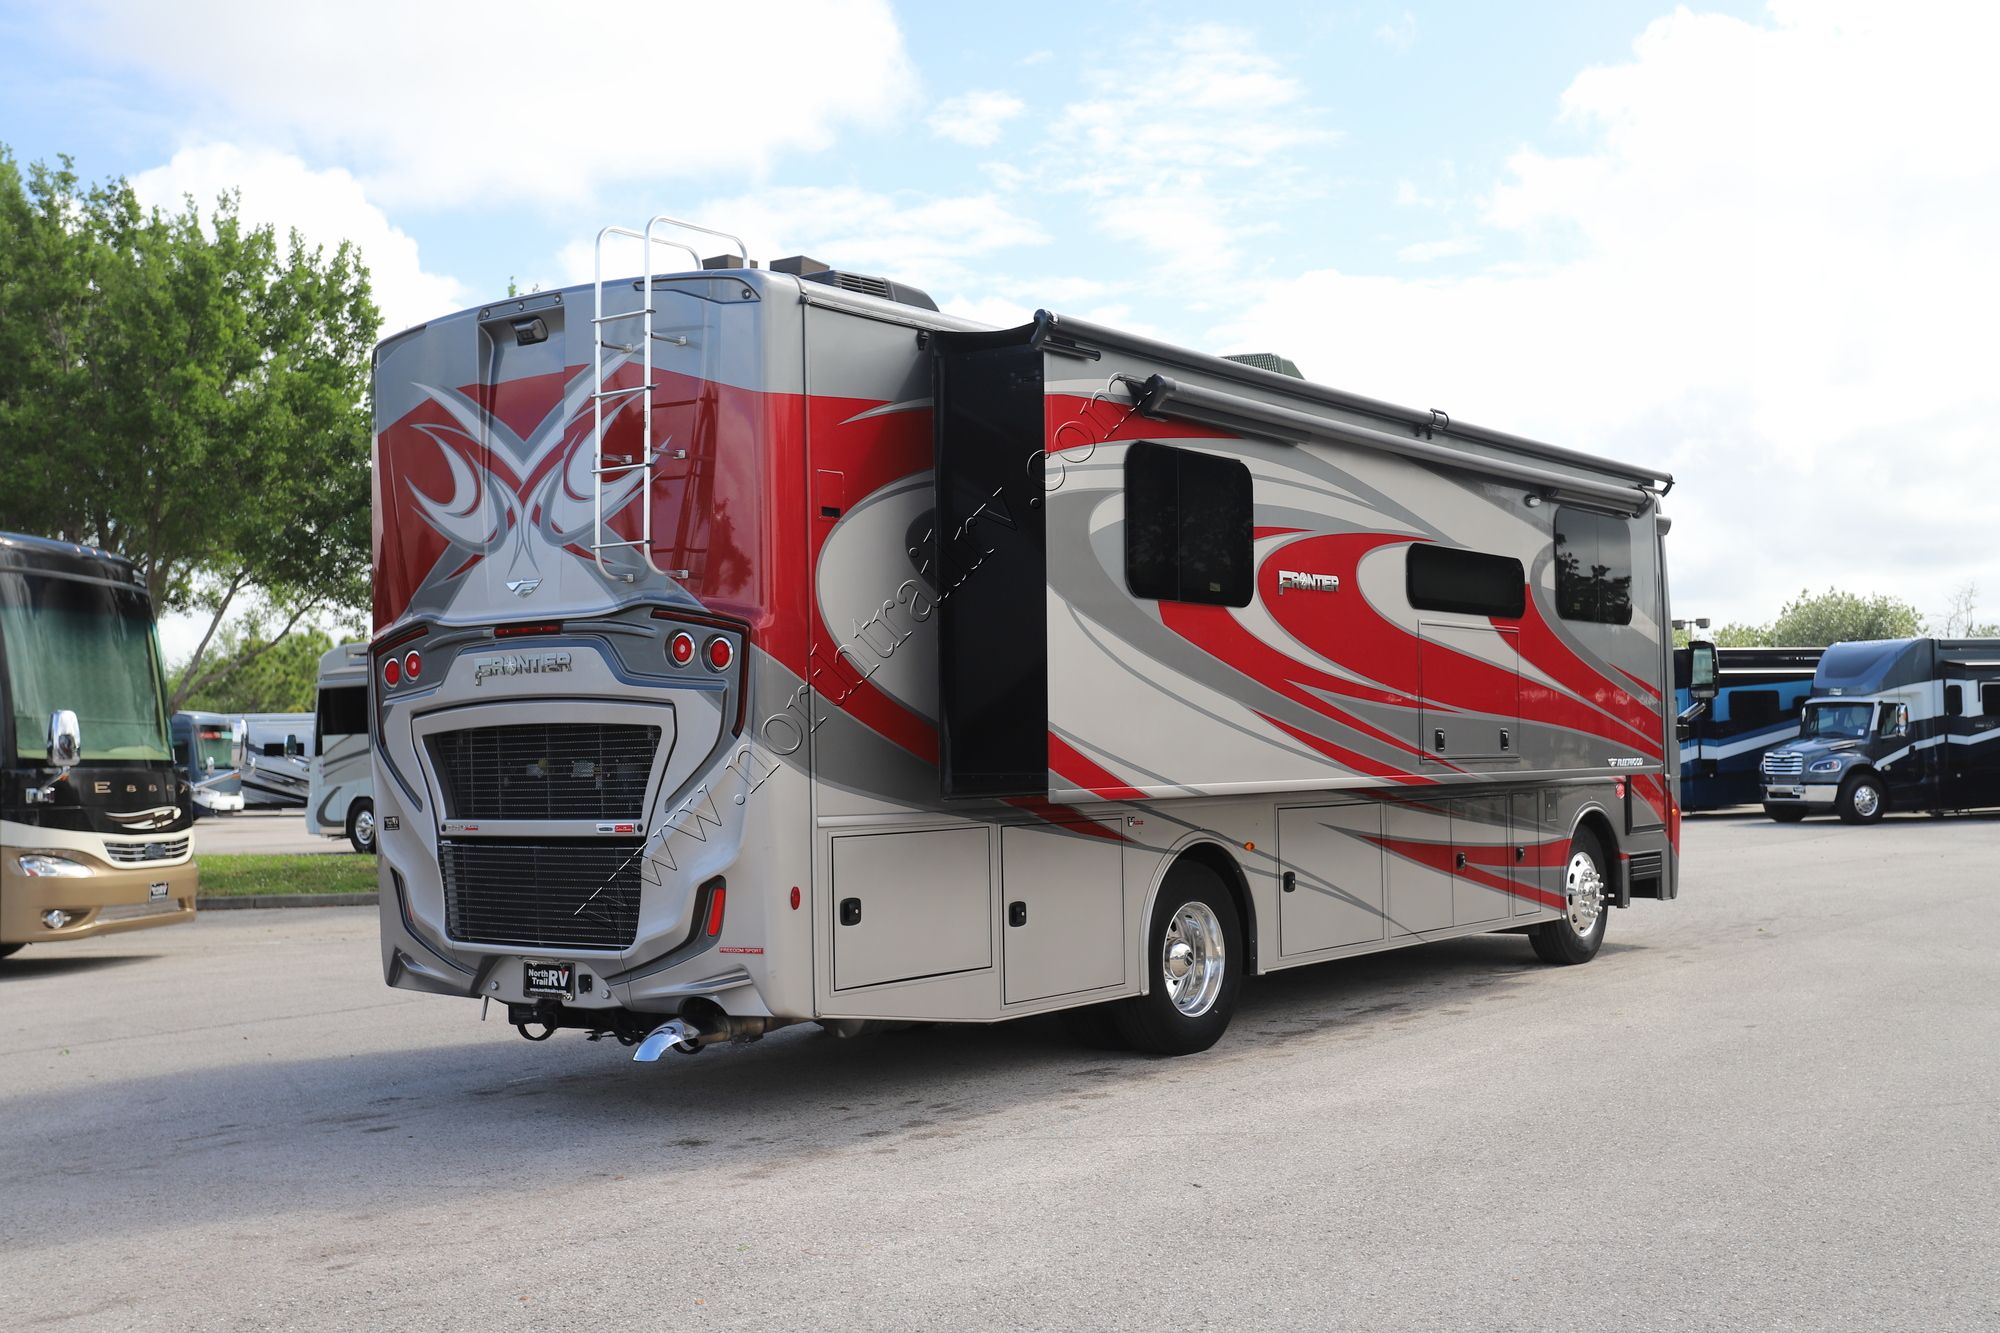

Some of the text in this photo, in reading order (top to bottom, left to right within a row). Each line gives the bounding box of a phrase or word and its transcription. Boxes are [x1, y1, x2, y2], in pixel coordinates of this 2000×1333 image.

[1279, 570, 1339, 595] FRONTIER
[475, 653, 572, 686] FRONTIER
[528, 969, 548, 977] North
[532, 977, 548, 985] Trail
[549, 970, 569, 987] RV
